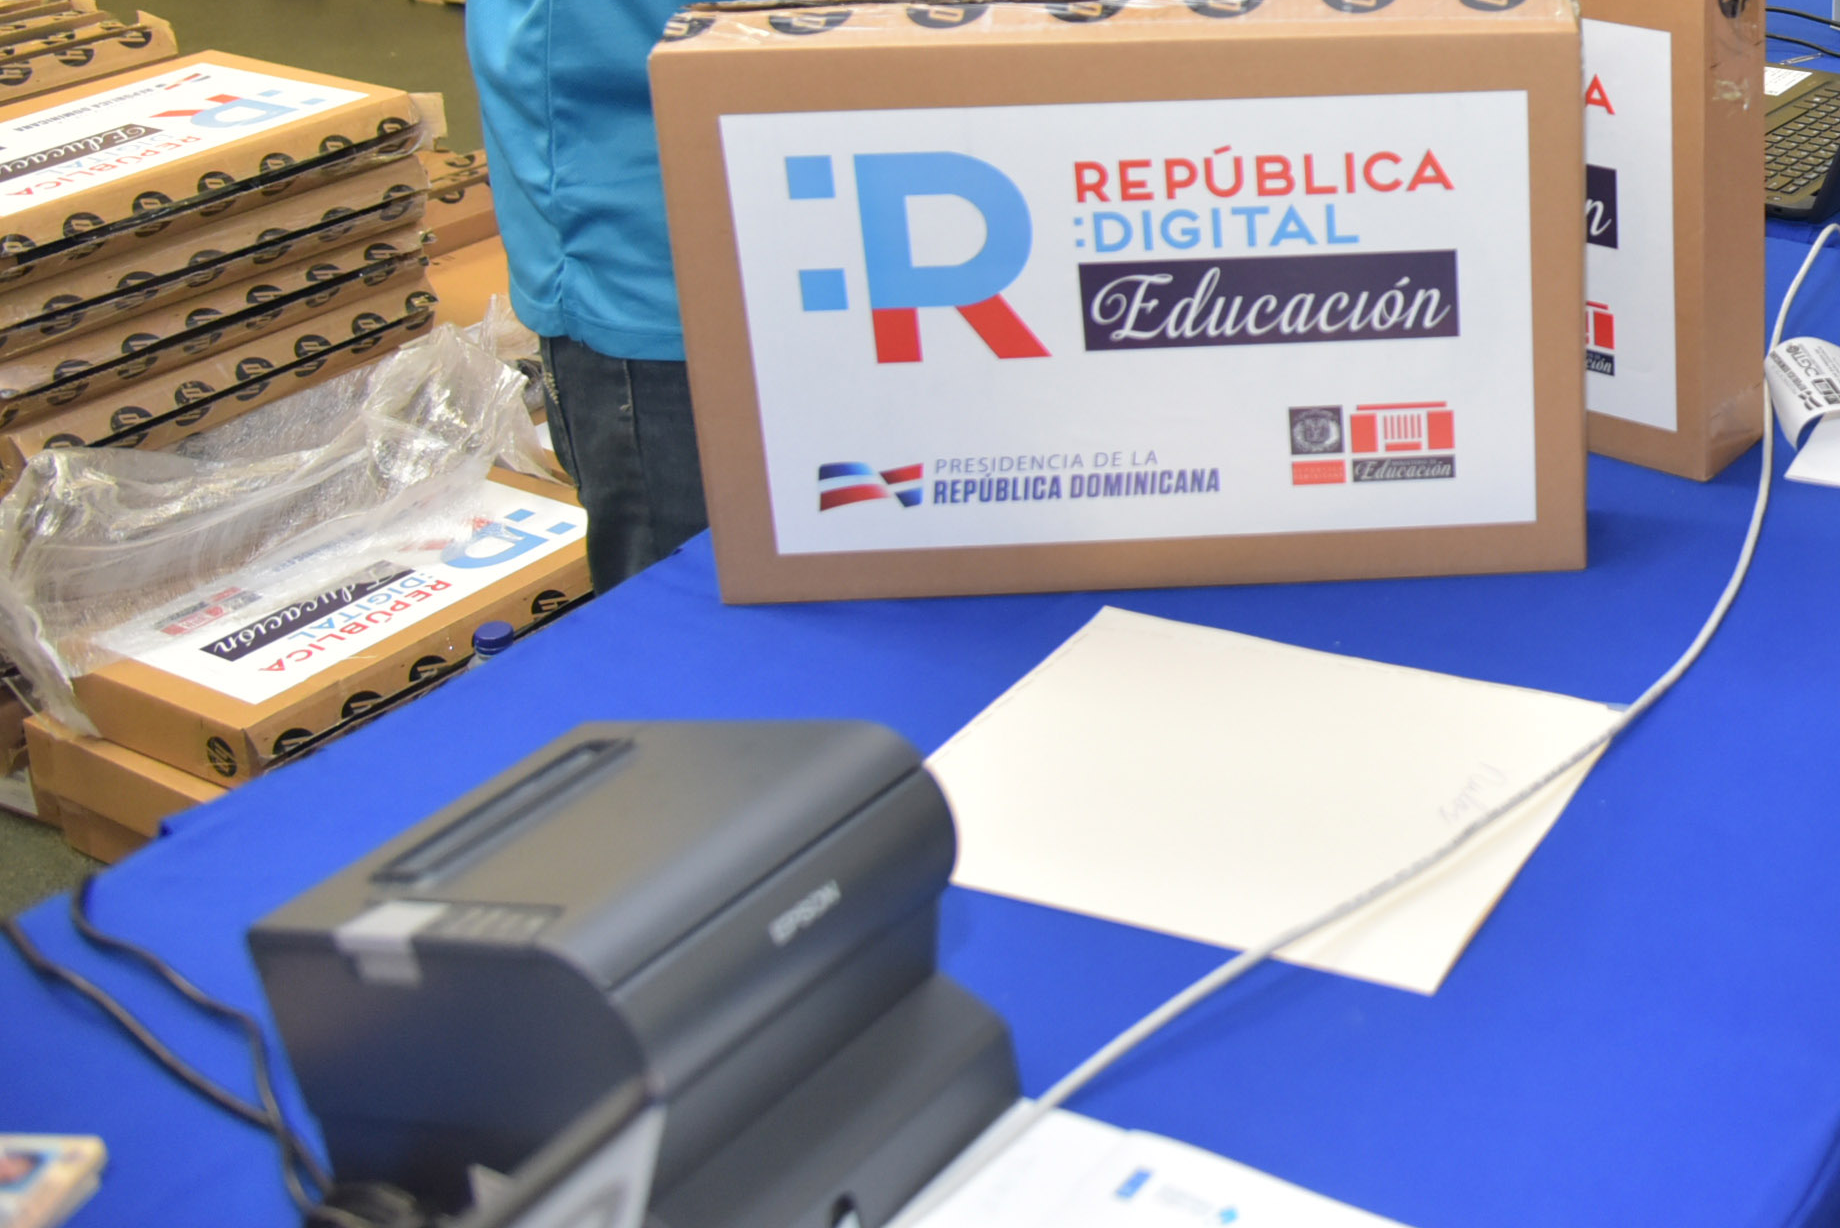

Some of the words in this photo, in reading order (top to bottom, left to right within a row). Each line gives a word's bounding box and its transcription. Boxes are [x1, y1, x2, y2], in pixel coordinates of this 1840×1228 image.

[5, 135, 202, 197] REPÚBLICA
[1073, 145, 1455, 203] REPÚBLICA
[1090, 267, 1451, 342] Educación
[933, 473, 1063, 504] REPÚBLICA
[1069, 468, 1221, 499] DOMINICANA
[935, 452, 1084, 474] PRESIDENCIA
[1093, 451, 1123, 468] DE
[1131, 450, 1159, 466] LA
[1354, 459, 1452, 480] Educación
[257, 578, 453, 673] REPÚBLICA
